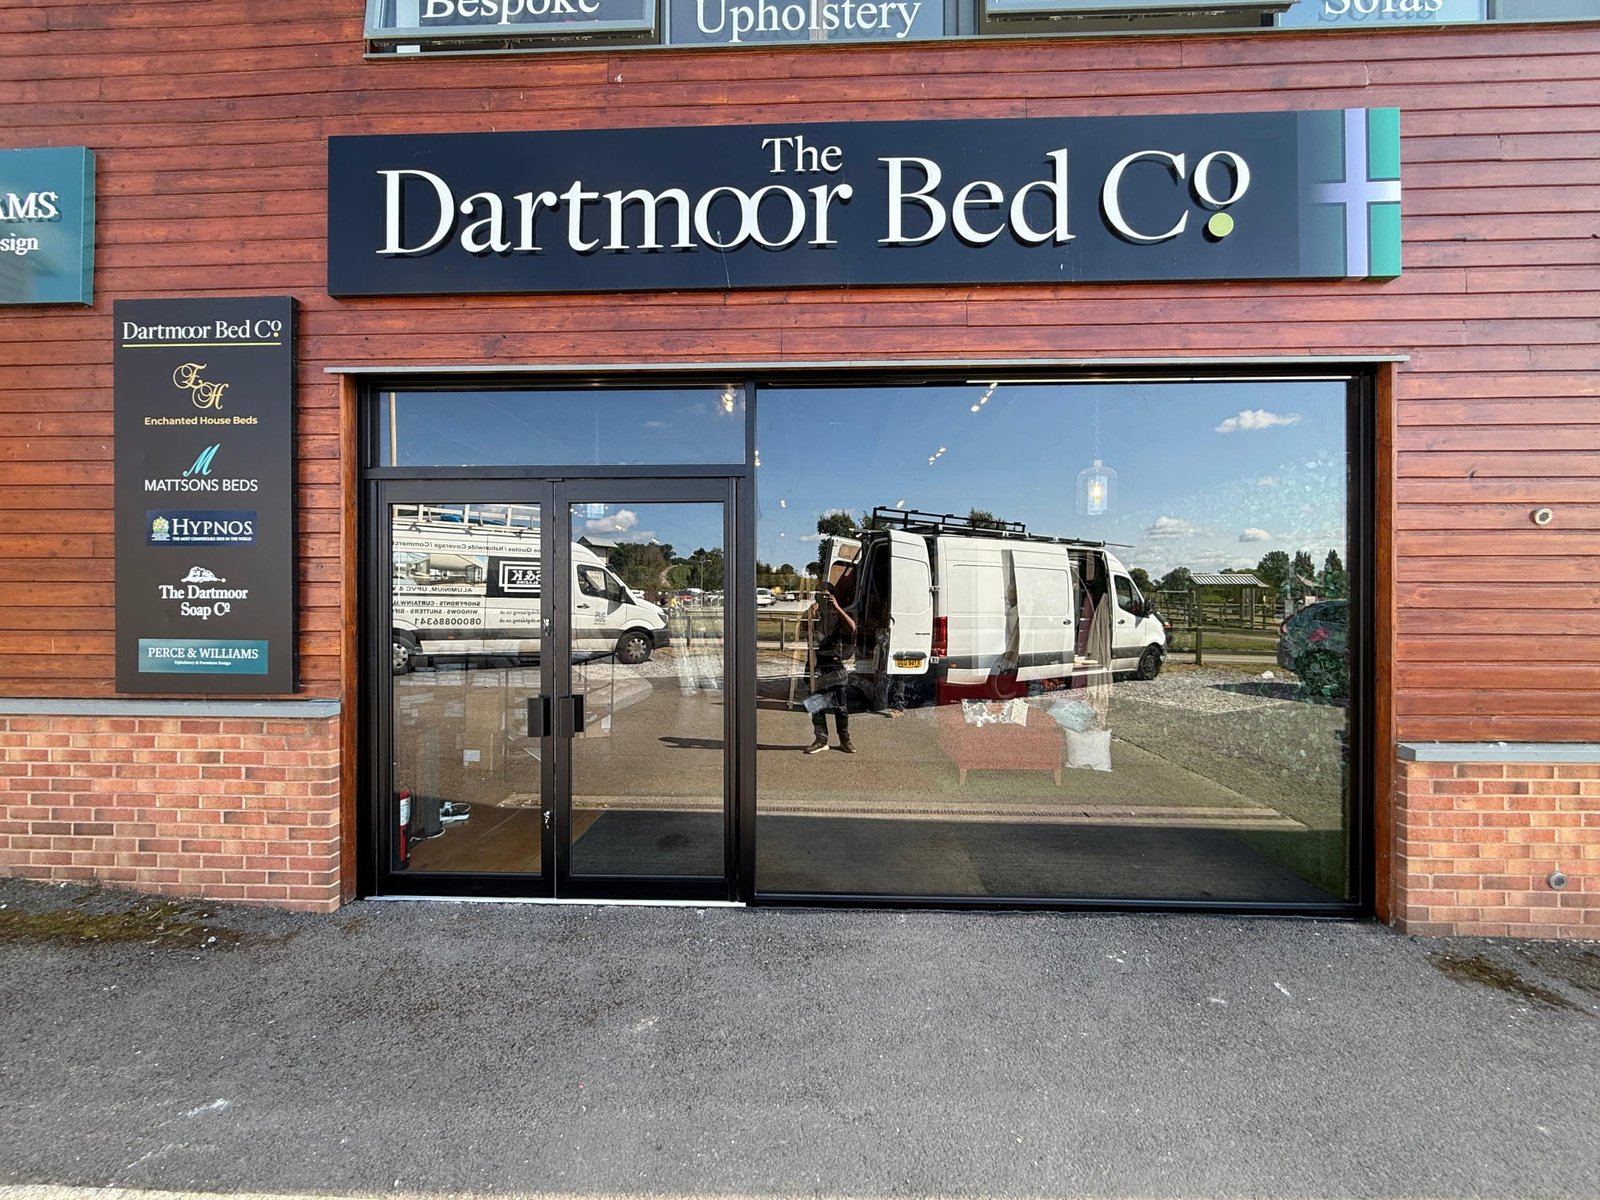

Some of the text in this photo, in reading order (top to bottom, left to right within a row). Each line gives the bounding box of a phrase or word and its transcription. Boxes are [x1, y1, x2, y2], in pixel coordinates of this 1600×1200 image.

[696, 0, 922, 43] Upholstery
[762, 135, 843, 173] The
[376, 169, 853, 256] Dartmoor
[878, 148, 1077, 245] Bed
[0, 233, 40, 255] sign
[122, 321, 211, 340] Dartmoor
[215, 320, 251, 339] Bed
[144, 415, 258, 426] Enchanted House Beds
[144, 479, 259, 492] MATTSONS BEDS
[158, 585, 249, 600] The Dartmoor
[181, 602, 211, 620] Soap
[147, 647, 259, 660] PERCE & WILLIAMS
